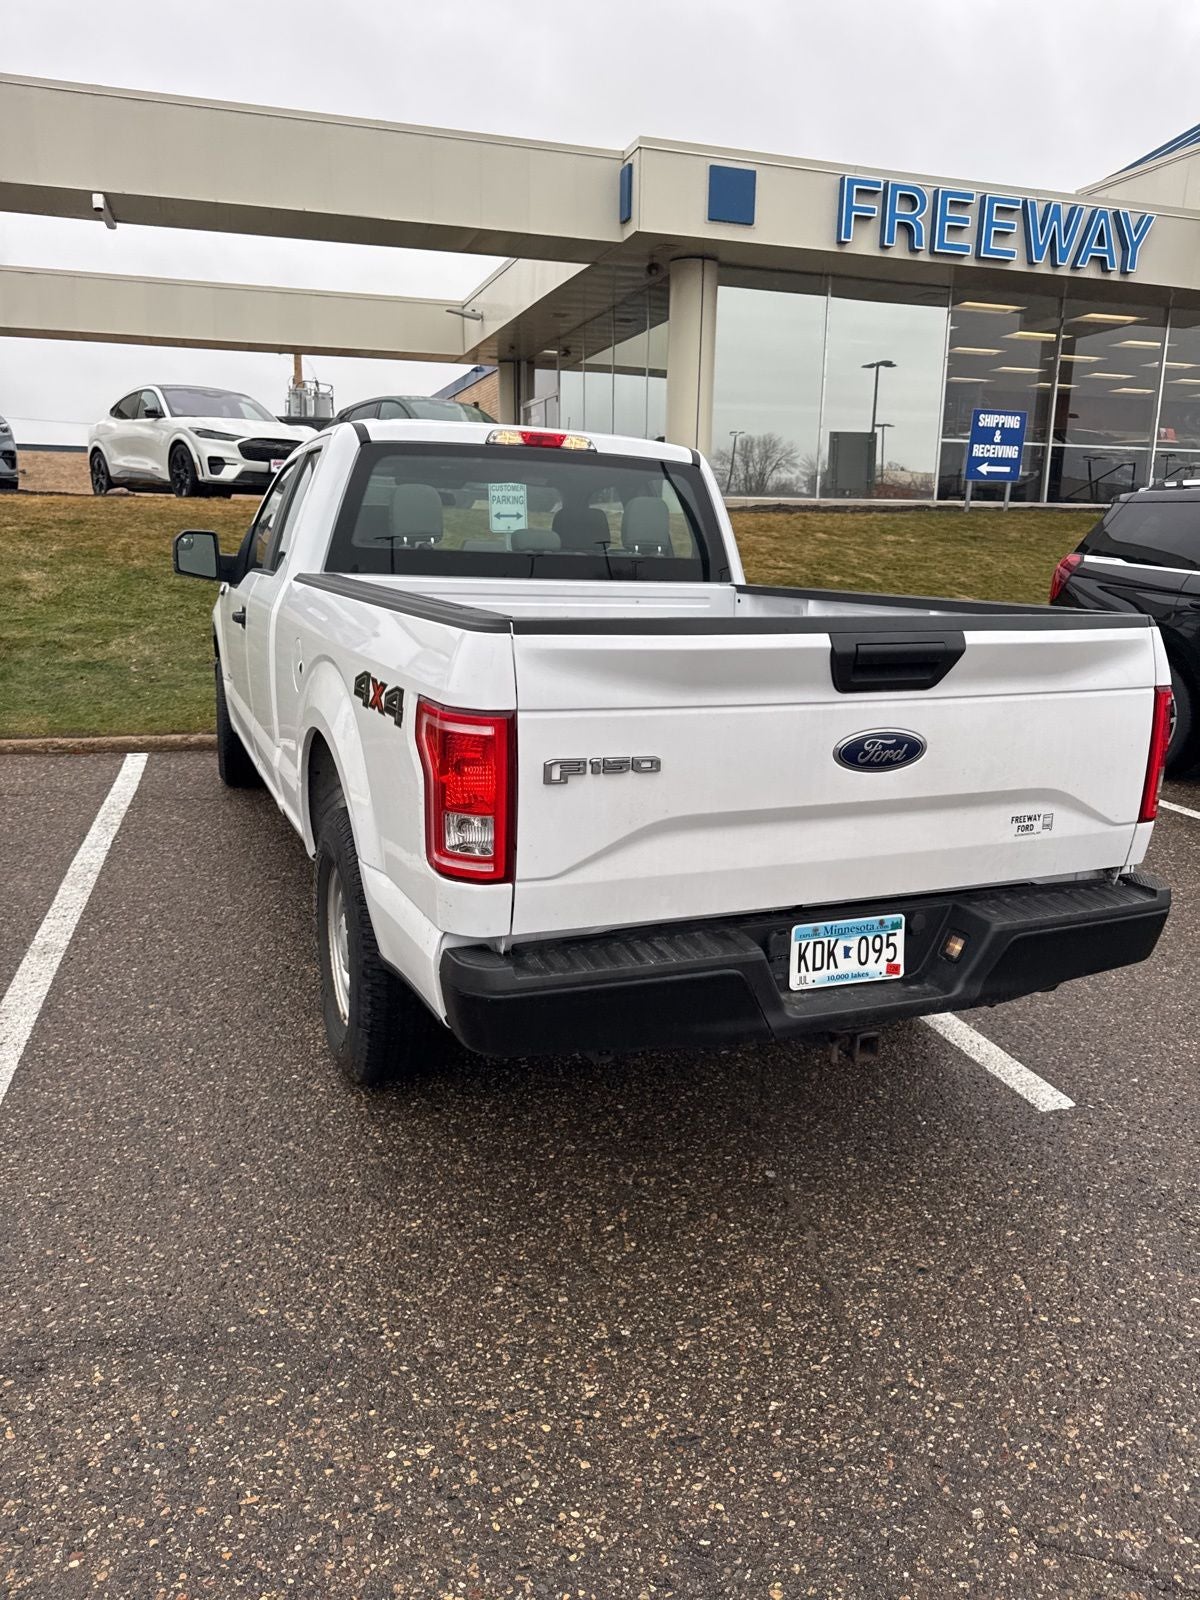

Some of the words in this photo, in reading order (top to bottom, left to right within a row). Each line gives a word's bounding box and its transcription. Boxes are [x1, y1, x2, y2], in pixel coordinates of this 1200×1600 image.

[837, 175, 1156, 274] FREEWAY
[978, 414, 1020, 428] SHIPPING
[993, 430, 1001, 442] &
[972, 444, 1019, 458] RECEIVING
[491, 495, 524, 505] PARKING
[857, 739, 909, 763] Ford
[1010, 814, 1041, 824] FREEWAY
[1016, 823, 1034, 832] FORD
[823, 925, 875, 936] Minnesota
[797, 938, 840, 973] KDK
[857, 932, 898, 966] 095
[797, 975, 809, 986] JUL
[826, 973, 850, 982] 10,000
[851, 971, 870, 979] lakes
